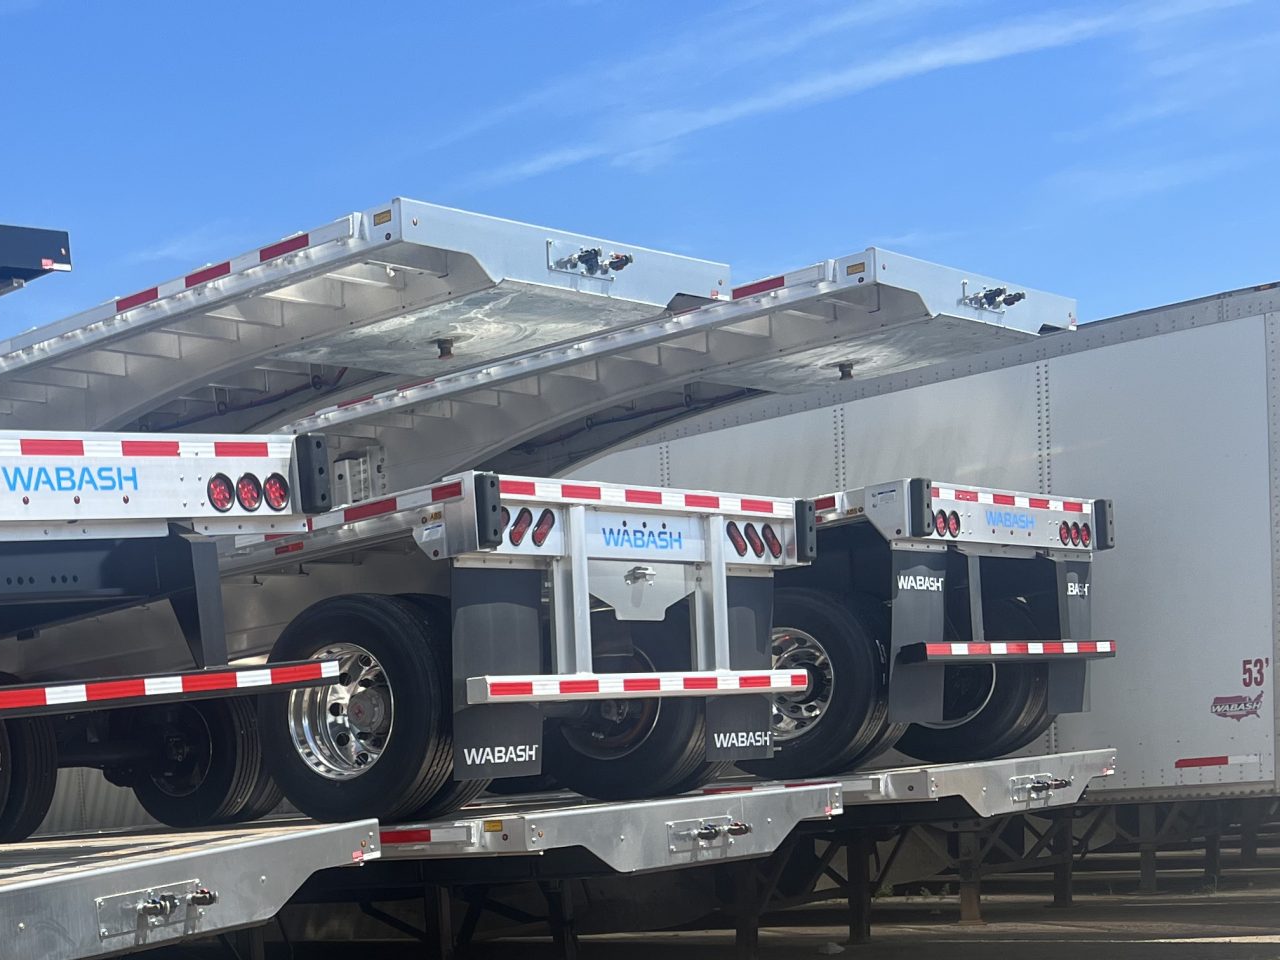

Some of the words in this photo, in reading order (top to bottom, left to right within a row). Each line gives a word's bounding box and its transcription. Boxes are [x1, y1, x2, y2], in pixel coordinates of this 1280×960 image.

[1, 466, 138, 491] WABASH
[985, 511, 1036, 529] WABASH
[602, 528, 682, 549] WABASH
[897, 575, 944, 591] WABASH
[1067, 582, 1089, 596] BASH
[1242, 657, 1269, 687] 53'
[1211, 702, 1262, 713] WABASH
[713, 731, 771, 748] WABASH
[463, 745, 538, 765] WABASH
